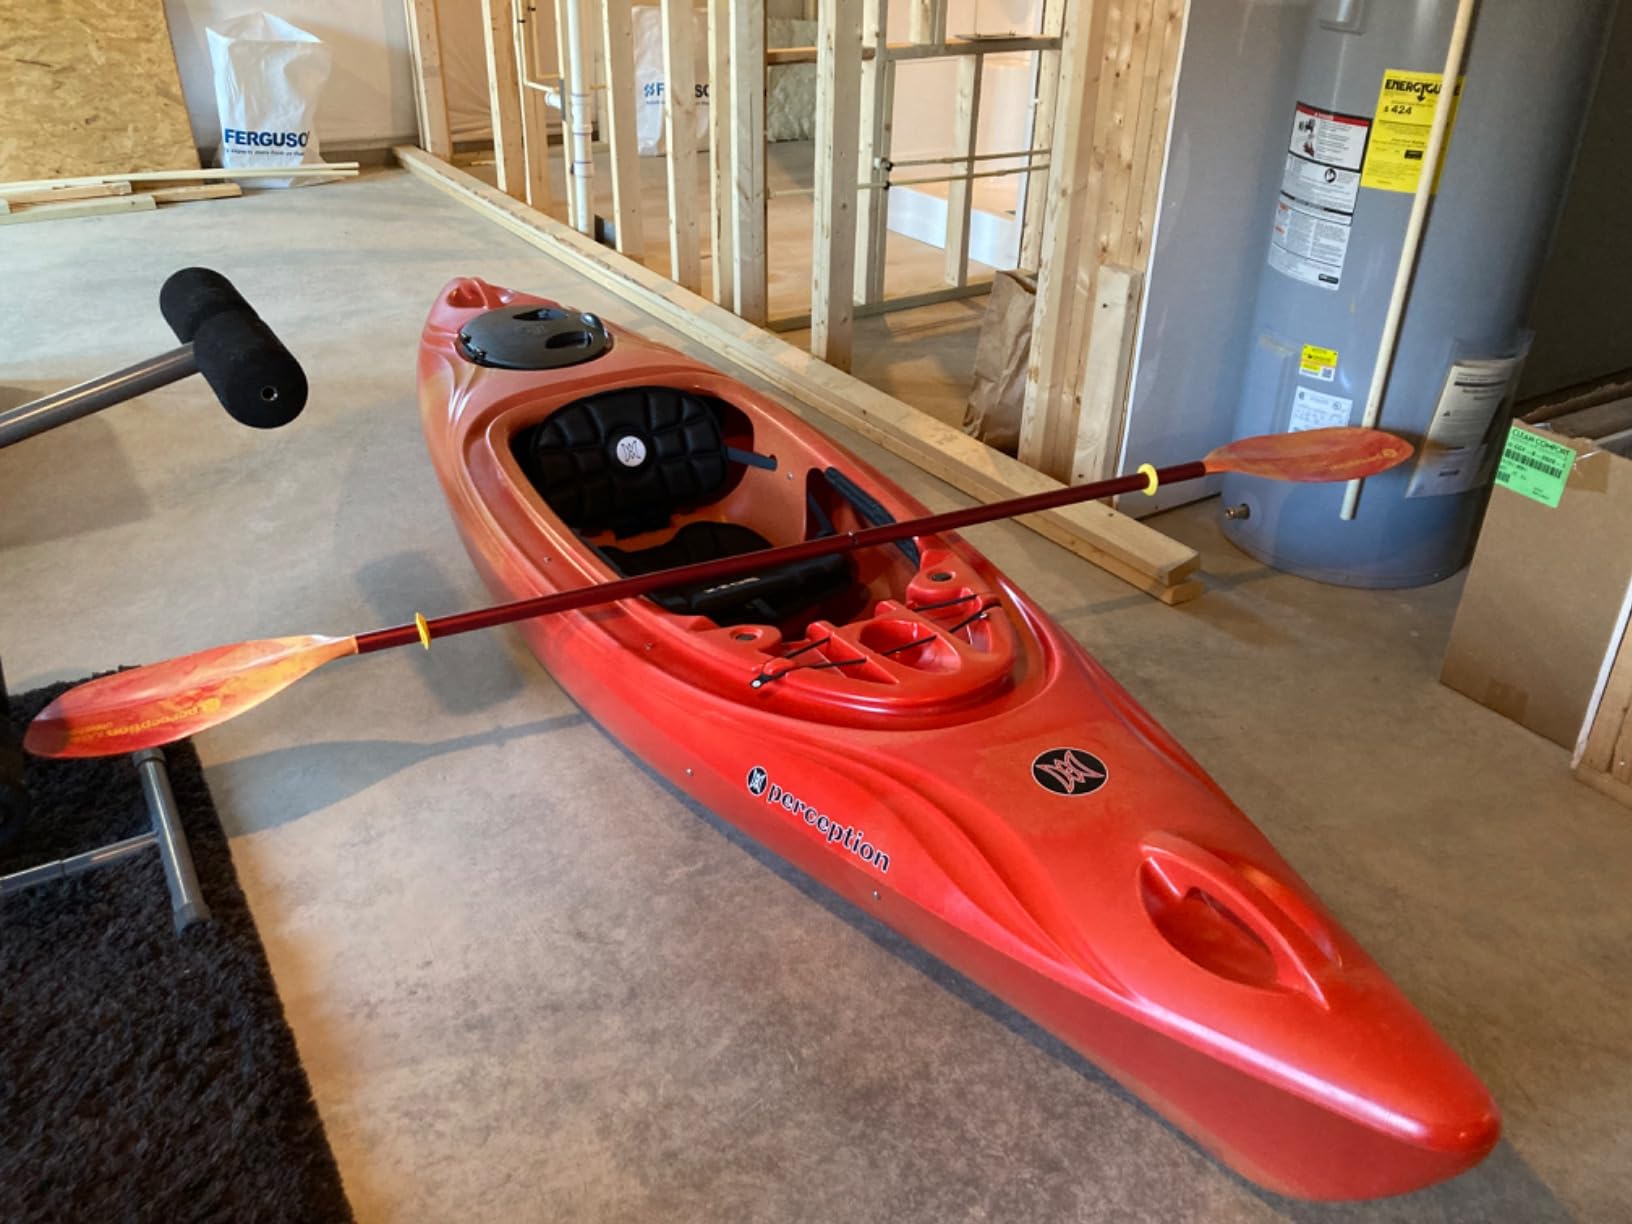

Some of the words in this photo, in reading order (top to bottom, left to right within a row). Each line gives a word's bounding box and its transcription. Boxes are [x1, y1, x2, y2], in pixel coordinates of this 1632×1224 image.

[1385, 79, 1461, 101] ENERGYGUE
[224, 128, 310, 147] FERGUSO
[767, 783, 890, 872] perception
